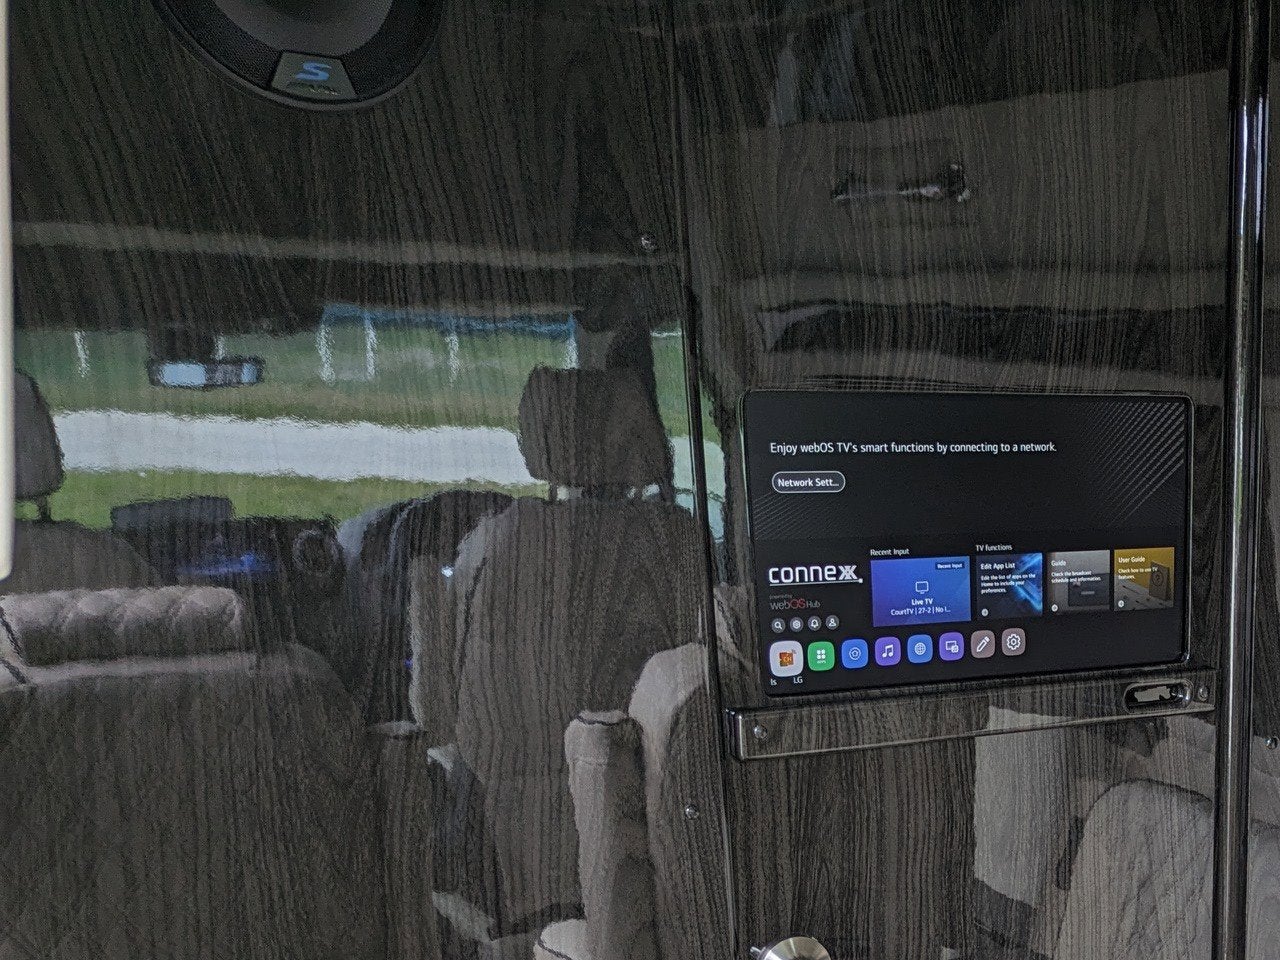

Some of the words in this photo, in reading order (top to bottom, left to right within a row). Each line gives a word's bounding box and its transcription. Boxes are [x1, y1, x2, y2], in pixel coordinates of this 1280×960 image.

[770, 442, 797, 455] Enjoy
[800, 442, 834, 453] webOS
[836, 442, 858, 453] TV's
[860, 442, 888, 453] smart
[891, 441, 934, 453] functions
[937, 442, 947, 454] by
[950, 442, 998, 454] connecting
[1001, 443, 1010, 452] to
[1012, 444, 1018, 452] a
[1020, 442, 1057, 452] network.
[778, 478, 813, 487] Network
[894, 548, 909, 556] Input
[891, 608, 914, 616] CourtTV
[793, 676, 803, 684] LG
